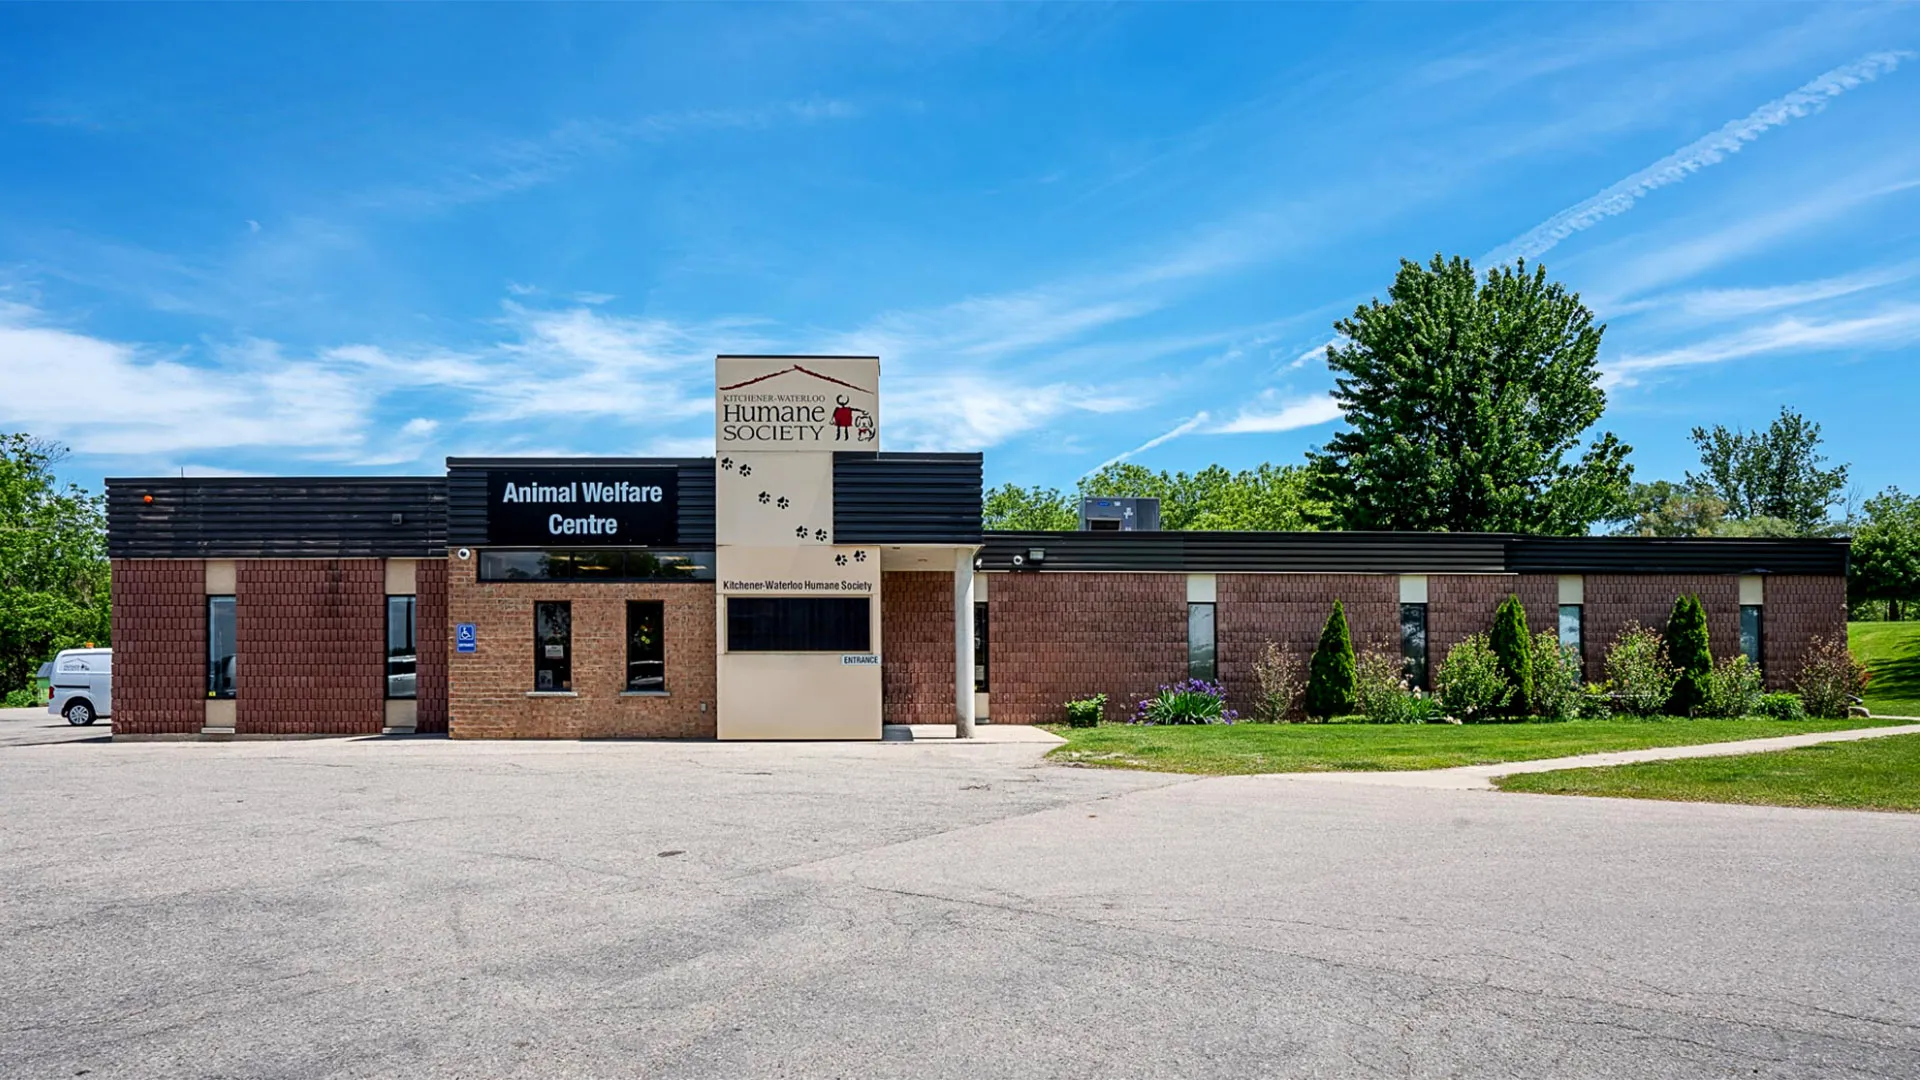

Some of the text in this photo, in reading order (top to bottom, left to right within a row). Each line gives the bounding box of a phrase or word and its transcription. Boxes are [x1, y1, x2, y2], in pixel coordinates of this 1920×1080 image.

[723, 394, 826, 403] KITCHENER-WATERLOO
[723, 404, 826, 423] Humane
[723, 425, 825, 441] SOCIETY
[502, 481, 663, 503] Animal Welfare
[548, 513, 618, 535] Centre
[723, 580, 872, 592] Kitchener-Waterloo Humane Society
[843, 656, 879, 665] ENTRANCE
